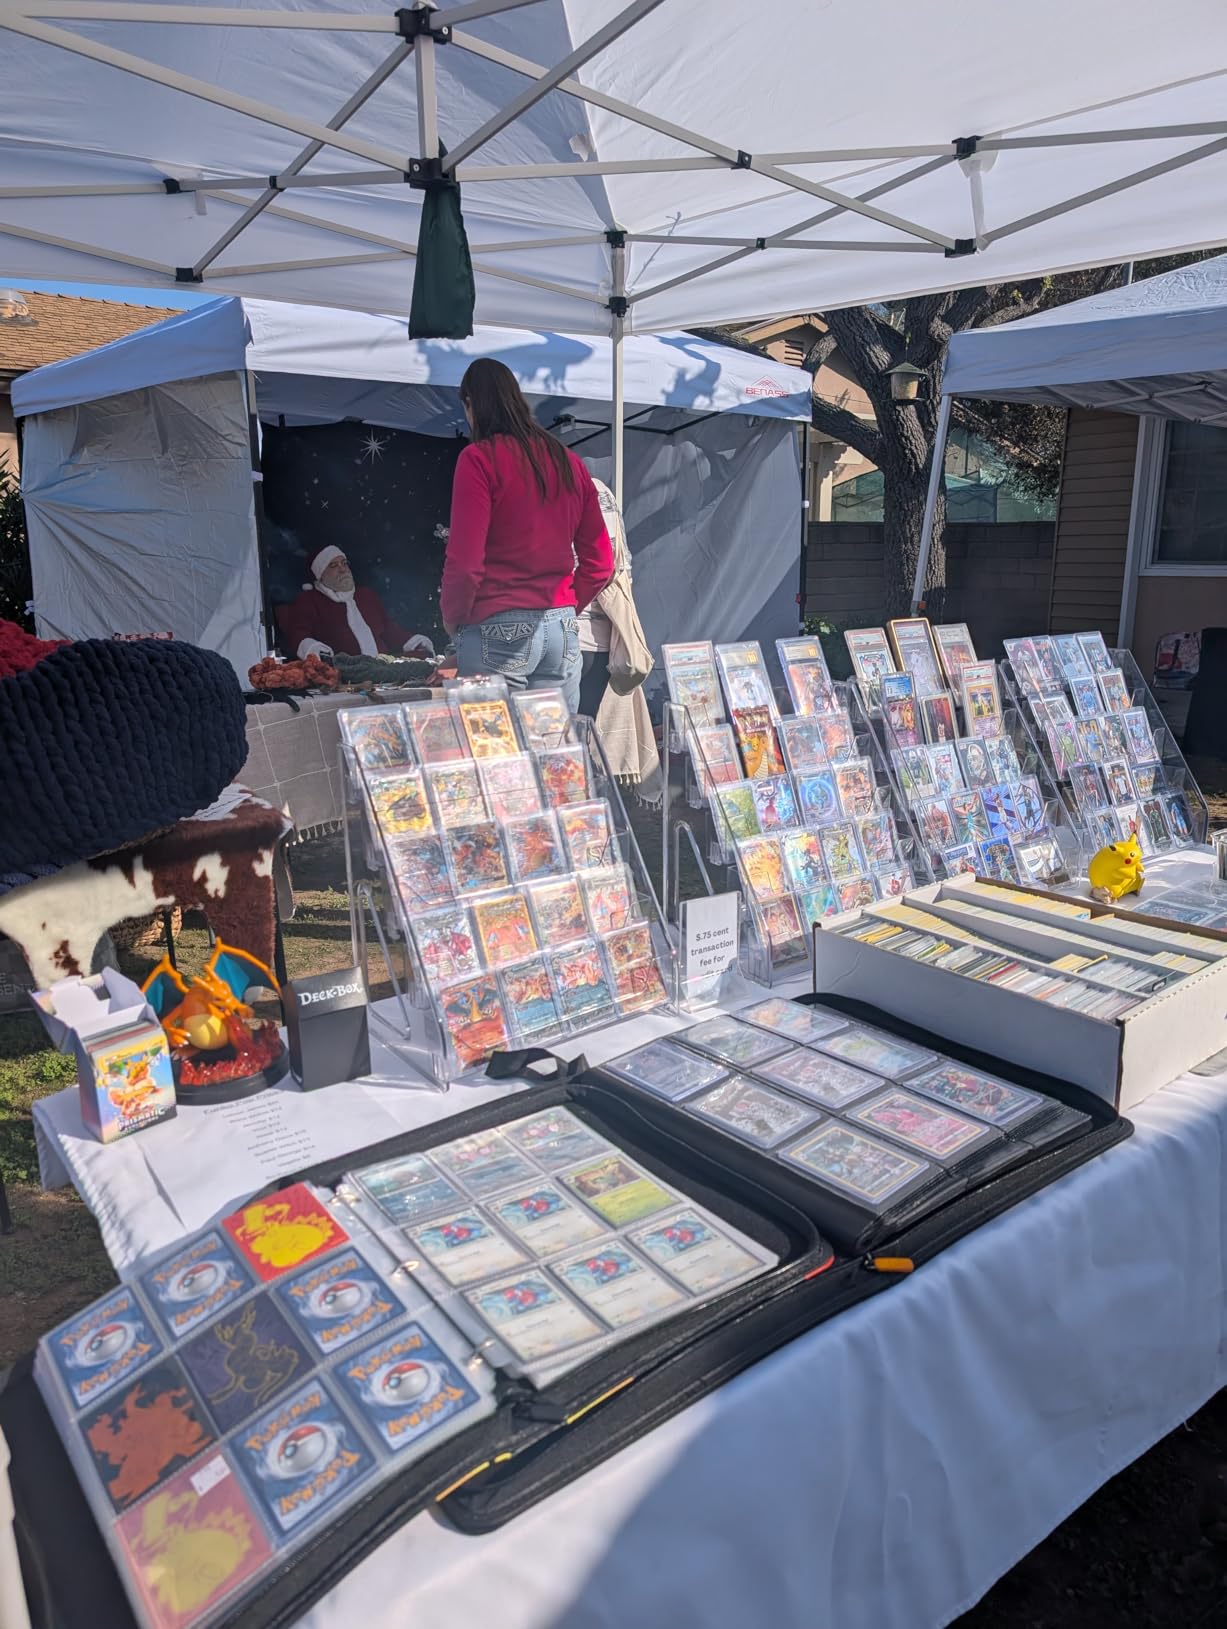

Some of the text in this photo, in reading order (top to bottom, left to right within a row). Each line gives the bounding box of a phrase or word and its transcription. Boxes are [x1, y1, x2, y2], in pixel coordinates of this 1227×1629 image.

[713, 927, 729, 937] cent
[691, 939, 734, 956] transaction
[700, 955, 725, 967] fee for
